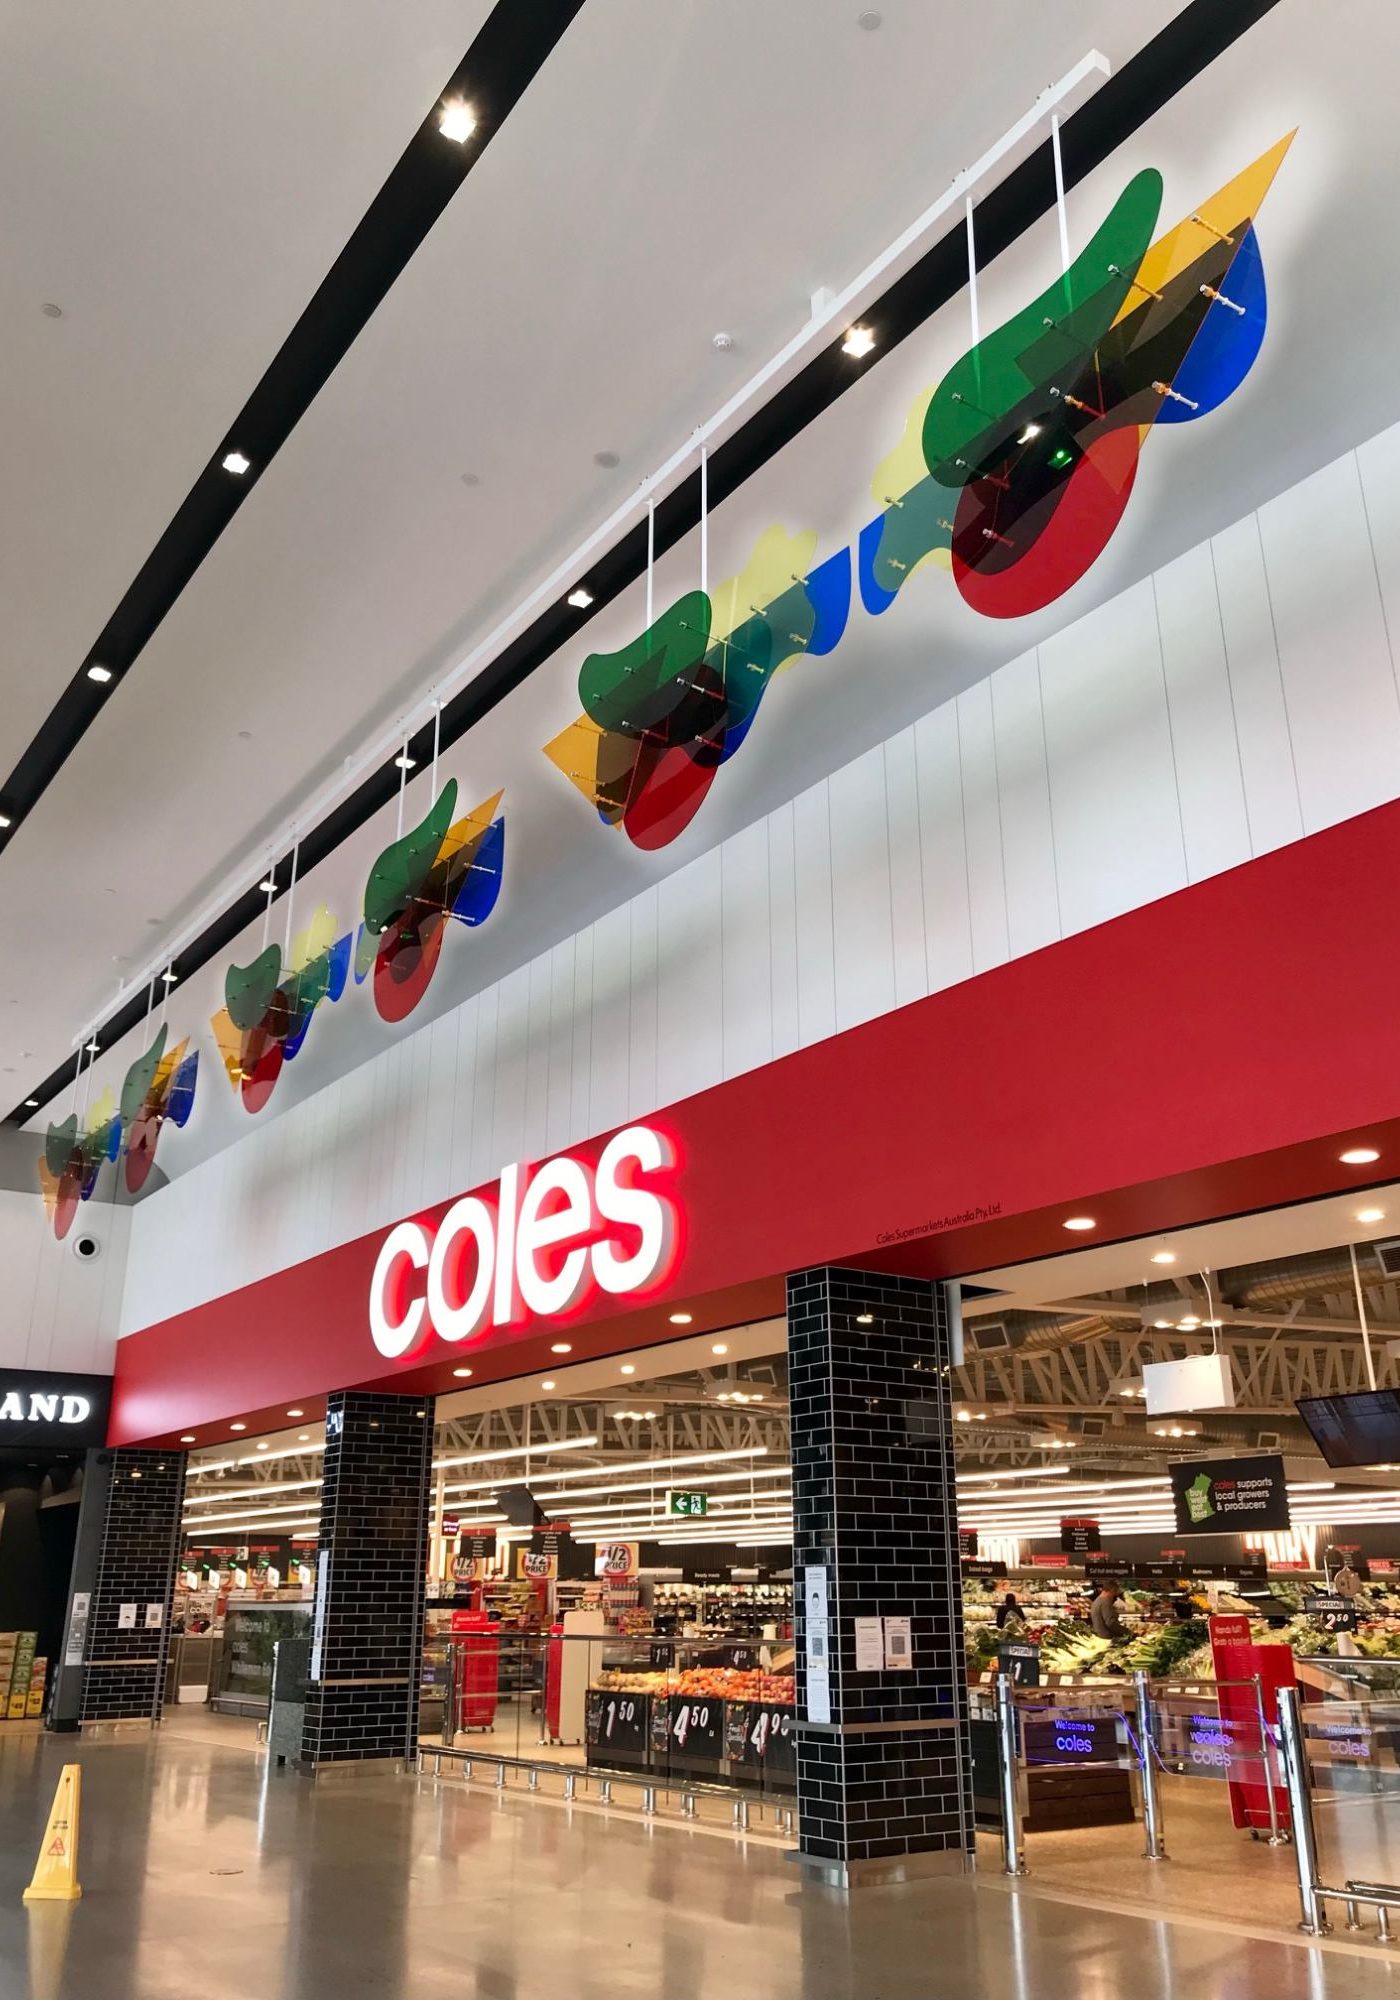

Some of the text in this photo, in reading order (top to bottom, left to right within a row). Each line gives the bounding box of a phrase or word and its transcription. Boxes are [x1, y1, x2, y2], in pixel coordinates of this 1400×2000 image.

[876, 1233, 895, 1244] Coles
[896, 1220, 944, 1240] Supermarkets
[943, 1211, 975, 1228] Australia
[369, 1126, 662, 1358] coles
[1214, 1477, 1273, 1489] coles supports
[1215, 1489, 1270, 1501] local growers
[1216, 1501, 1267, 1512] & producers
[525, 1564, 548, 1573] PRICE
[1055, 1719, 1086, 1731] Welcome
[1056, 1734, 1093, 1752] coles
[1329, 1739, 1370, 1757] coles
[1192, 1750, 1231, 1767] coles
